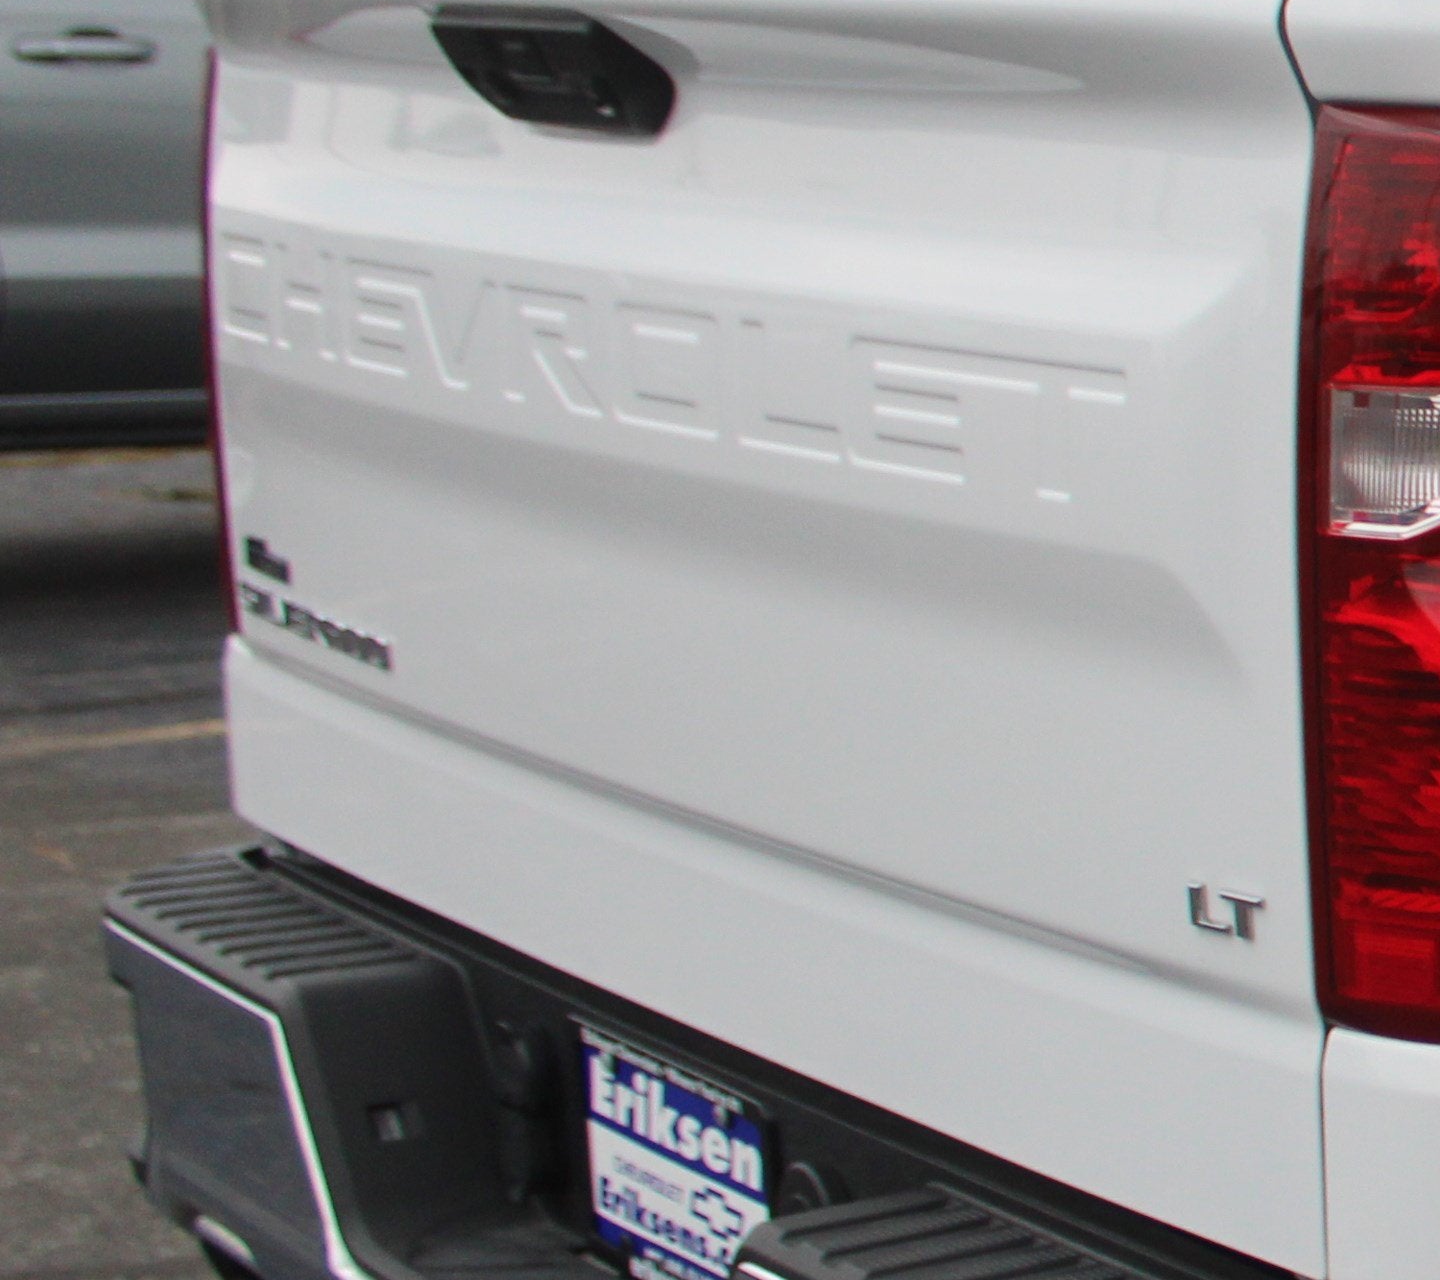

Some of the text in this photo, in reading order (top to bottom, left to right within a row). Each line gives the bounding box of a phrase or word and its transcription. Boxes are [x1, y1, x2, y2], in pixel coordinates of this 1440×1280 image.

[222, 231, 1127, 502] CHEVROLET
[1185, 881, 1267, 942] LT
[589, 1052, 764, 1194] Eriksen
